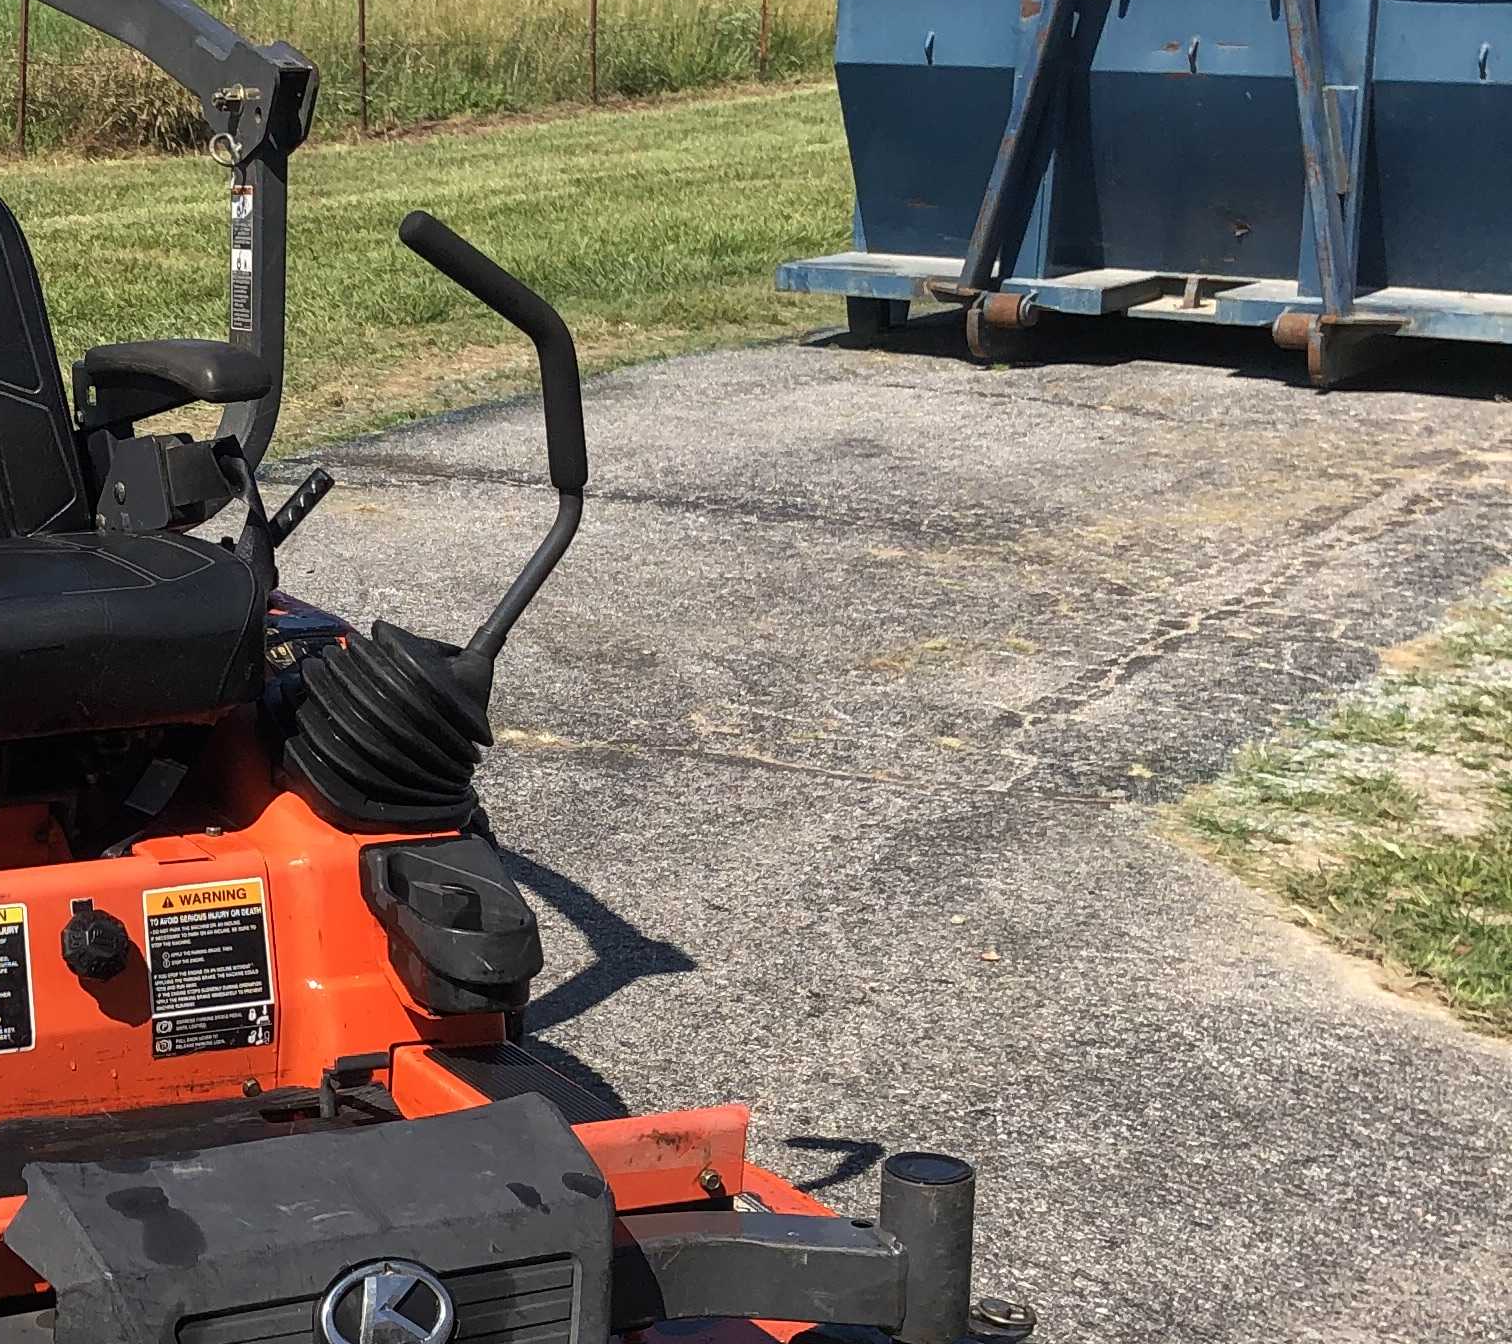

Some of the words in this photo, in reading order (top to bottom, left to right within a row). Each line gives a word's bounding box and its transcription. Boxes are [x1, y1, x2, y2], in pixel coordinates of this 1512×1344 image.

[179, 887, 247, 906] WARNING
[150, 918, 159, 927] TO
[160, 916, 178, 926] AVOID
[180, 913, 207, 923] SERIOUS
[208, 910, 230, 920] INJURY
[230, 909, 240, 917] OR
[241, 906, 262, 916] DEATH
